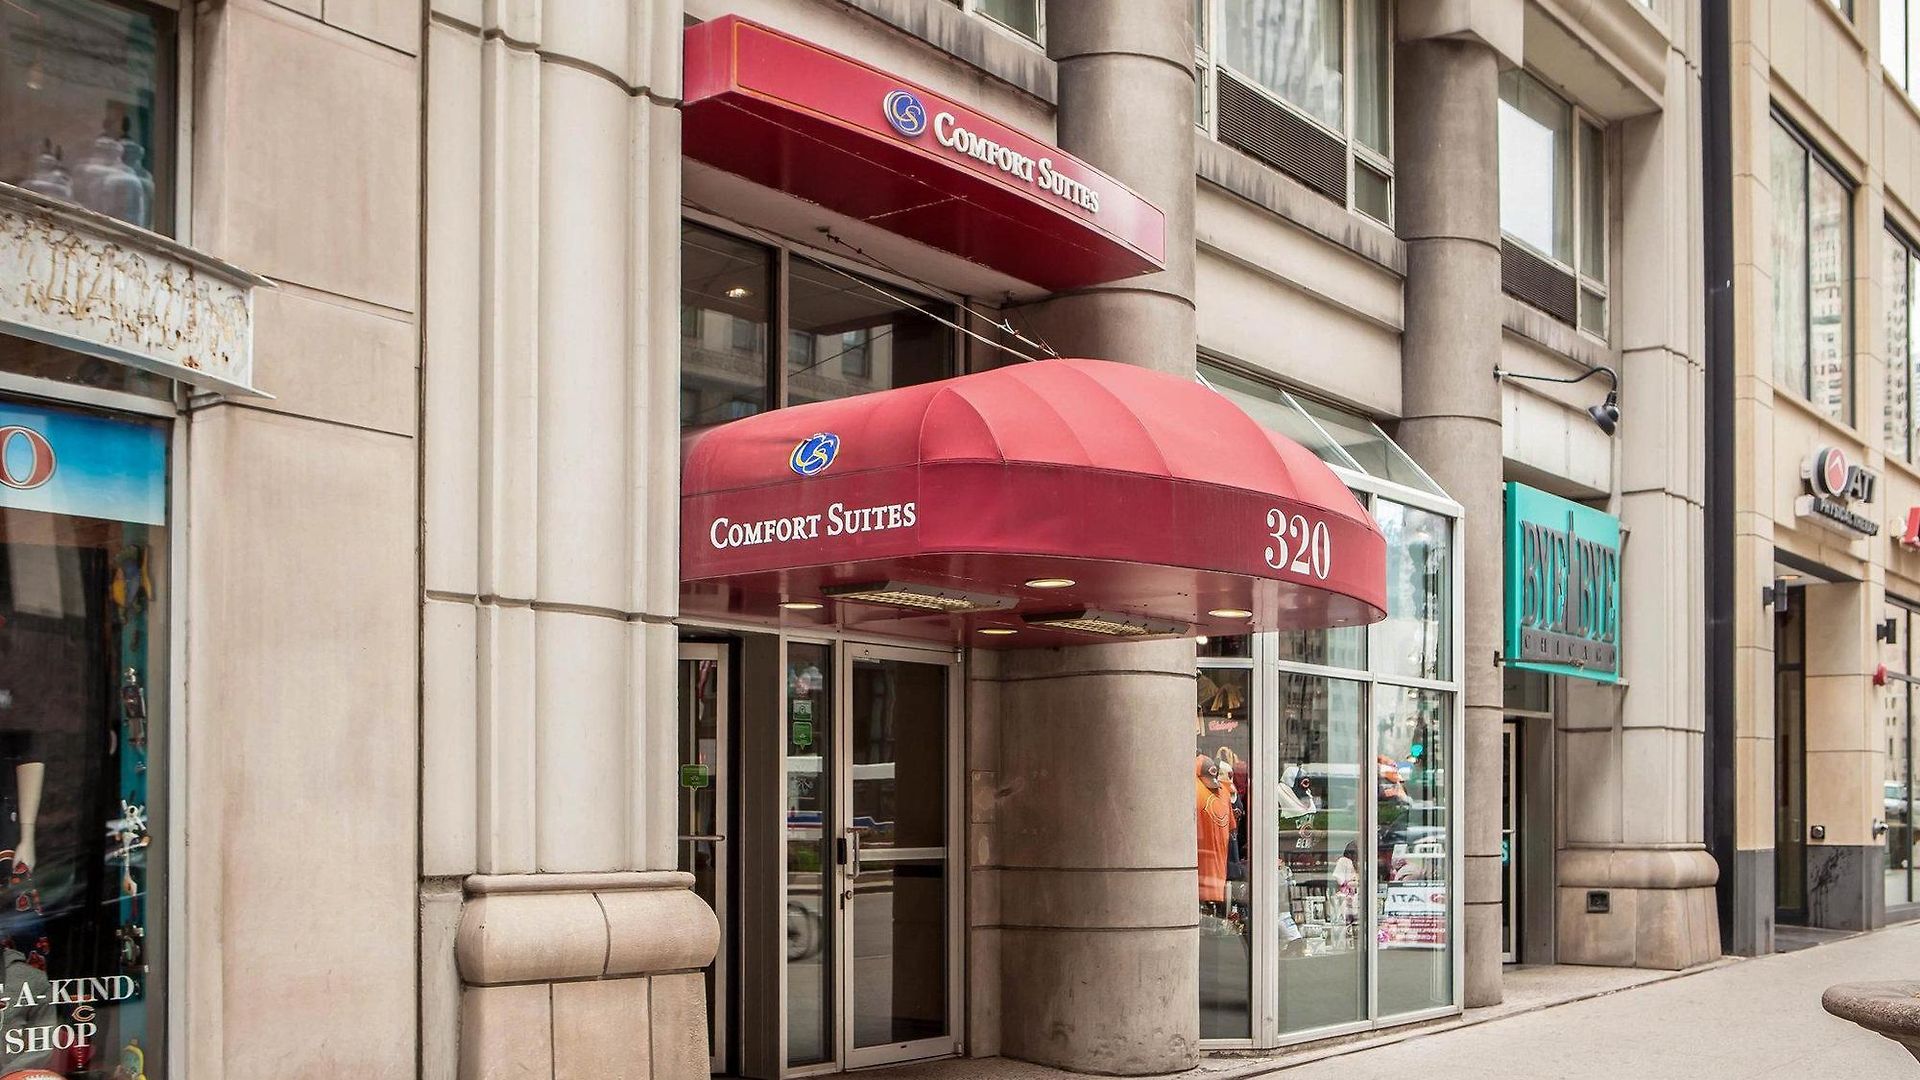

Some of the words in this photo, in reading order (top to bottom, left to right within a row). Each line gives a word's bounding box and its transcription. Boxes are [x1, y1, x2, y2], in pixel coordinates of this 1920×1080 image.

[934, 112, 1035, 182] COMFORT
[1037, 157, 1100, 213] SUITES
[1845, 465, 1874, 503] ATI
[710, 517, 822, 549] COMFORT
[827, 502, 917, 536] SUITES
[1265, 508, 1331, 580] 320
[1521, 520, 1567, 633] BYE
[1577, 537, 1616, 643] BYE
[1524, 634, 1616, 664] CHICAGO
[0, 975, 135, 1008] -A-KIND
[4, 1022, 98, 1055] SHOP
